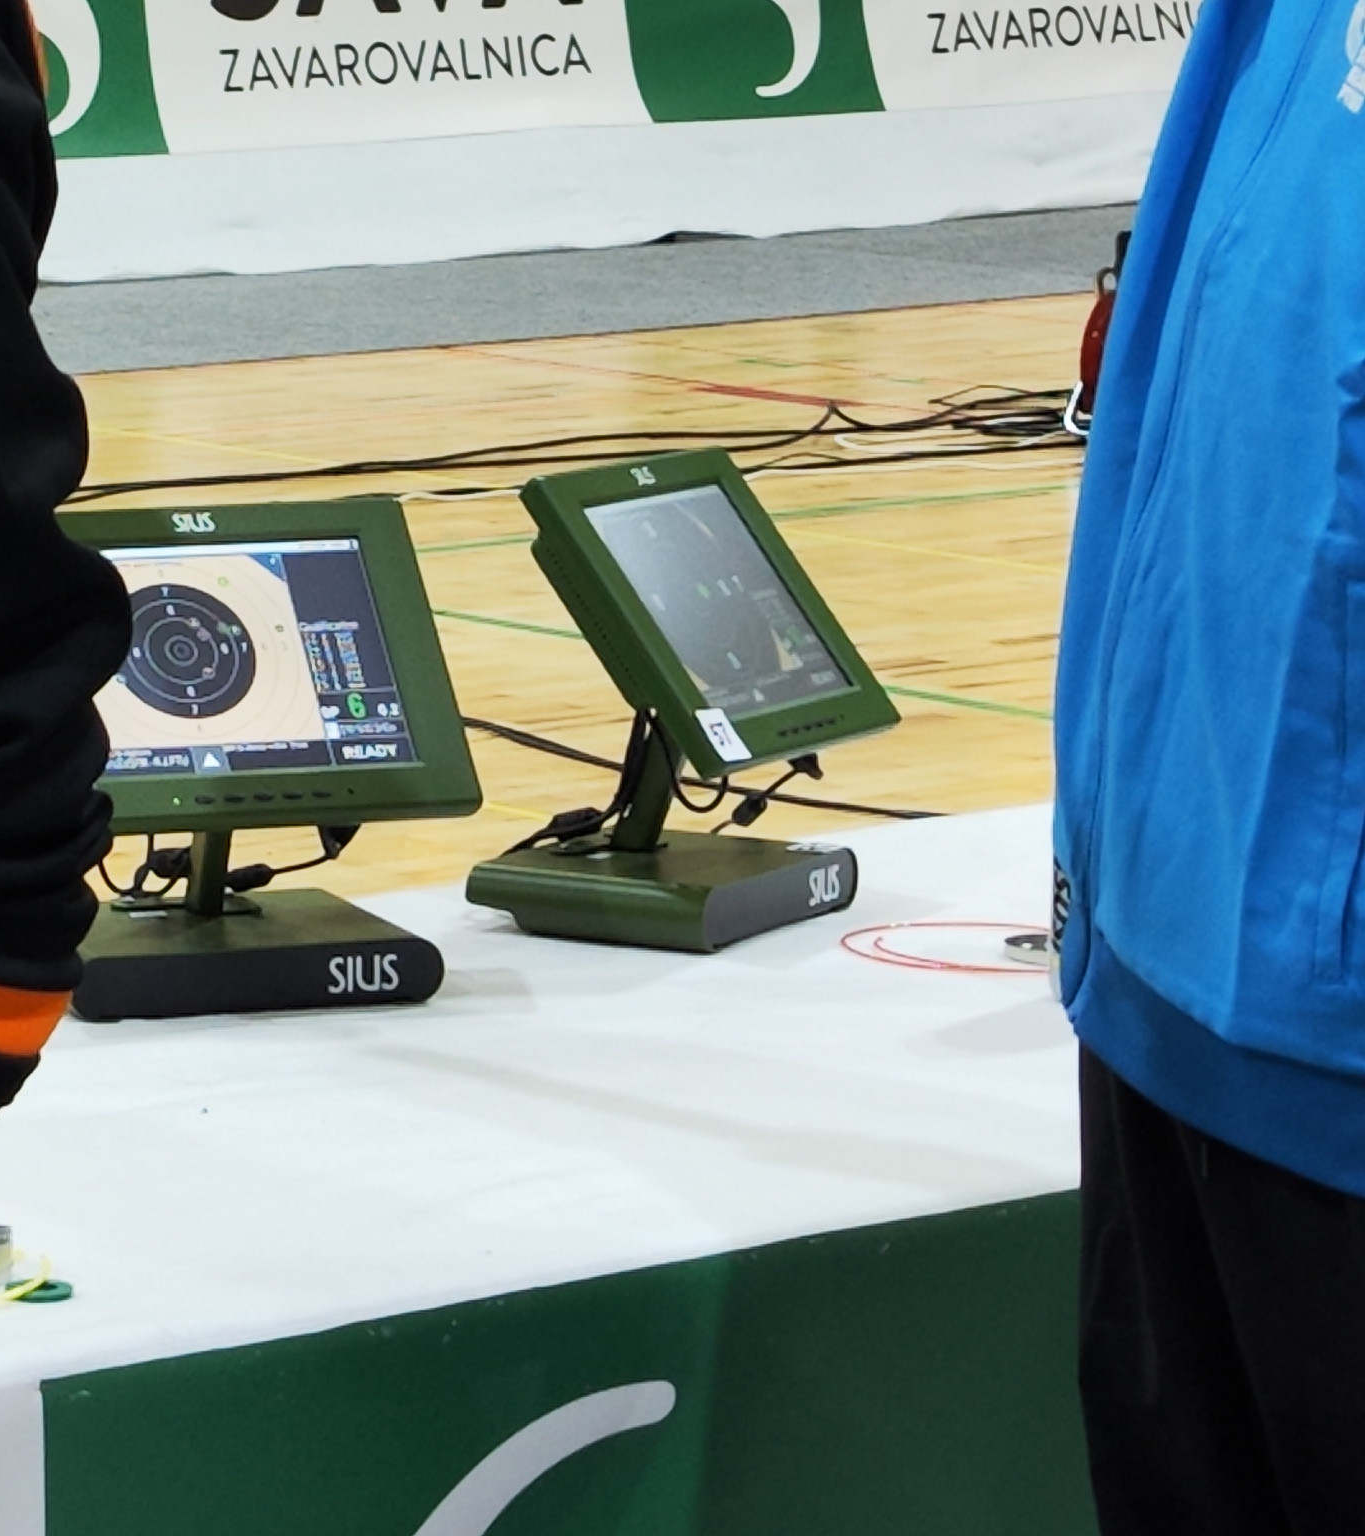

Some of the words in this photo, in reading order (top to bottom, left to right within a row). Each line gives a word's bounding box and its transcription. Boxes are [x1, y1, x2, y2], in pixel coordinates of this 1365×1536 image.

[927, 1, 1195, 54] ZAVAROVALNI
[218, 33, 592, 93] ZAVAROVALNICA
[172, 511, 216, 533] SIUS
[347, 693, 367, 719] 6
[328, 953, 399, 994] SIUS
